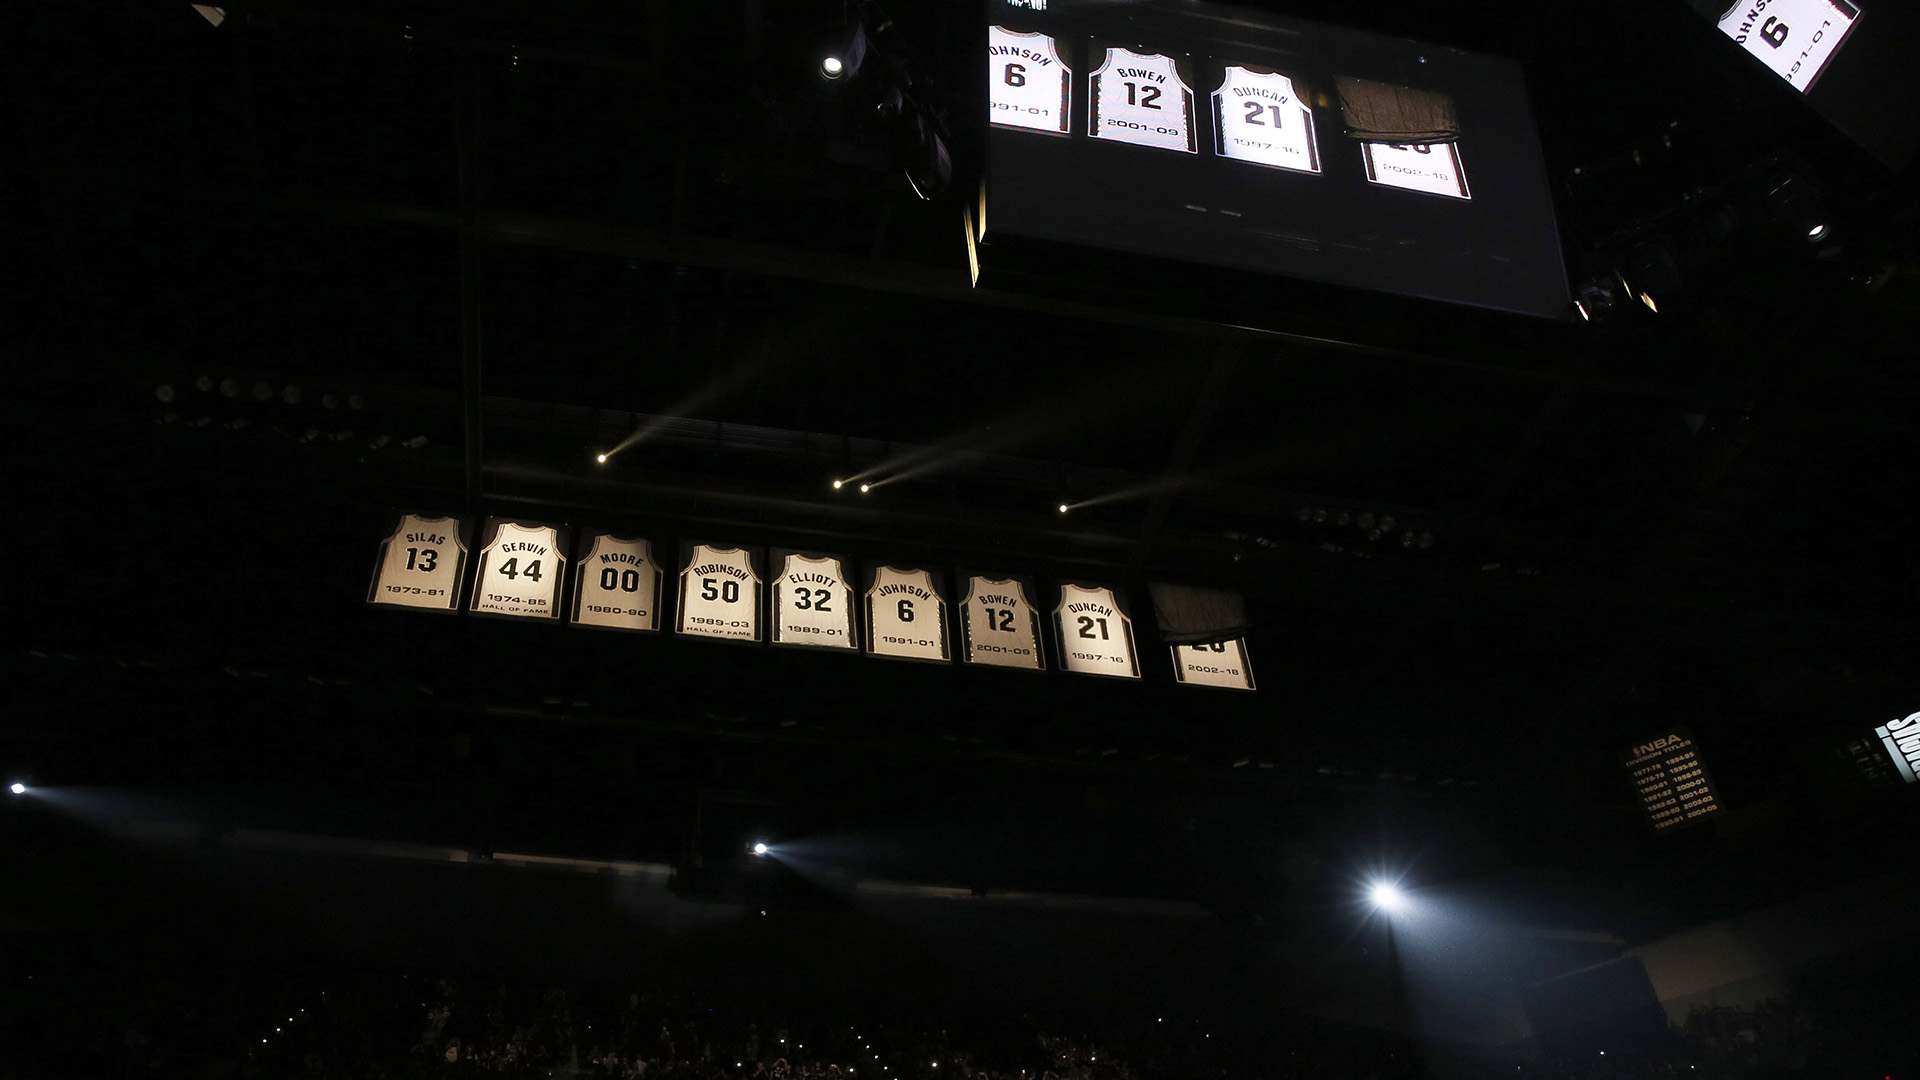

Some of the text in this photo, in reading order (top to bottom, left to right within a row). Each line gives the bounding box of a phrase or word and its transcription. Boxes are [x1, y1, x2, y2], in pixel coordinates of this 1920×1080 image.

[1735, 0, 1773, 44] OHNS
[1760, 15, 1789, 49] 6
[1004, 63, 1026, 87] 6
[1117, 68, 1167, 85] BOWEN
[1123, 82, 1162, 110] 12
[1233, 87, 1288, 105] DUNCAN
[1243, 101, 1282, 129] 21
[1107, 119, 1179, 136] 2001-09
[1233, 138, 1300, 155] 1997-16
[1382, 163, 1449, 181] 2002-18
[406, 533, 446, 545] SILAS
[502, 542, 547, 556] GERVIN
[406, 547, 438, 572] 13
[600, 553, 643, 568] MOORE
[499, 557, 542, 582] 44
[693, 563, 749, 581] ROBINSON
[600, 567, 639, 592] 00
[788, 572, 836, 588] ELLIOTT
[386, 585, 445, 596] 1973-81
[701, 578, 739, 604] 50
[879, 584, 931, 601] JOHNSON
[487, 594, 547, 606] 1974-85
[794, 587, 832, 612] 32
[979, 594, 1017, 608] BOWEN
[586, 605, 647, 617] 1980-90
[897, 599, 915, 622] 6
[1068, 602, 1113, 617] DUNCAN
[690, 617, 750, 628] 1989-03
[985, 608, 1016, 633] 12
[1077, 615, 1109, 640] 21
[787, 625, 843, 636] 1989-01
[882, 636, 934, 647] 1991-01
[977, 644, 1030, 656] 2001-09
[1072, 652, 1124, 663] 1997-16
[1188, 664, 1239, 676] 2002-18
[1640, 734, 1682, 755] NBA
[1625, 740, 1691, 767] DIVISION TITLES
